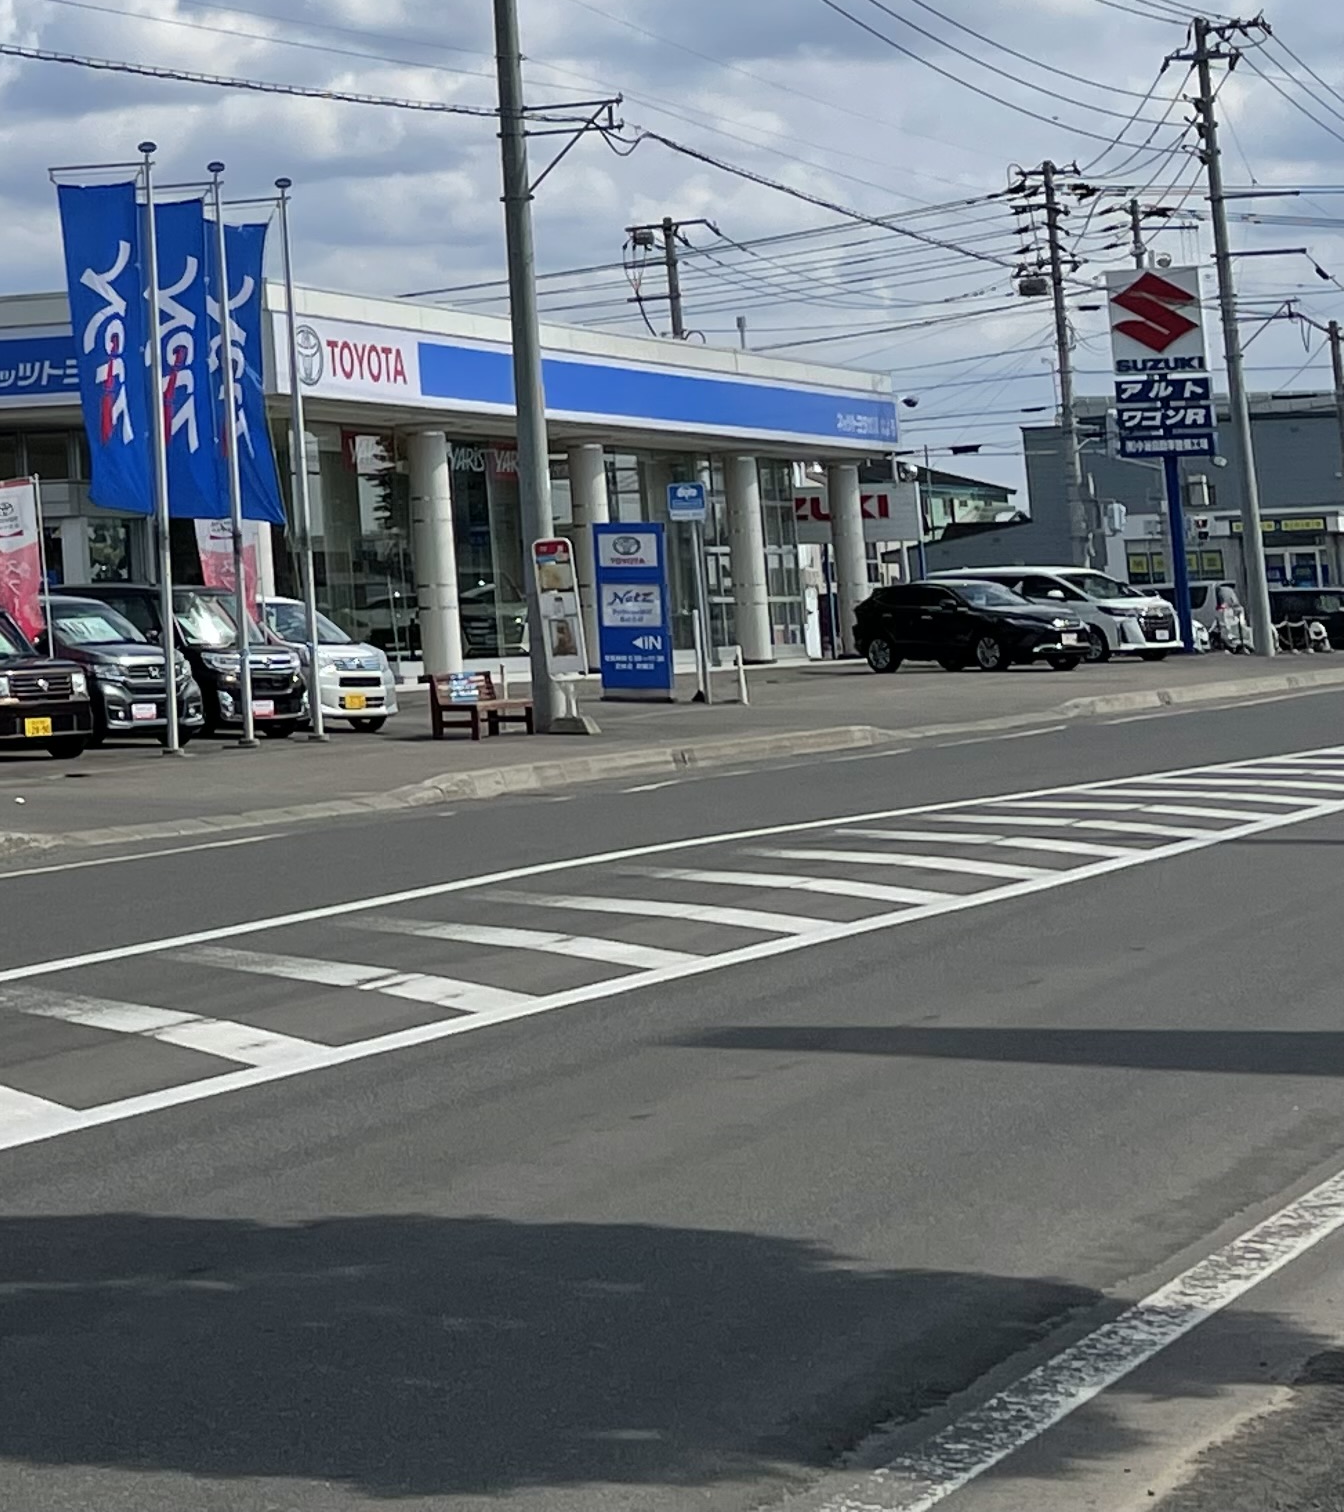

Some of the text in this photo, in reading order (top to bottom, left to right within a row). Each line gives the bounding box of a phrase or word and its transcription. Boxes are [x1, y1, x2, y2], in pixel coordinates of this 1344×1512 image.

[326, 339, 408, 385] TOYOTA
[1115, 356, 1205, 372] SUZUKI
[1120, 381, 1204, 399] アルト
[1122, 408, 1206, 427] ワゴンR
[607, 590, 655, 606] Netz
[644, 636, 662, 650] IN
